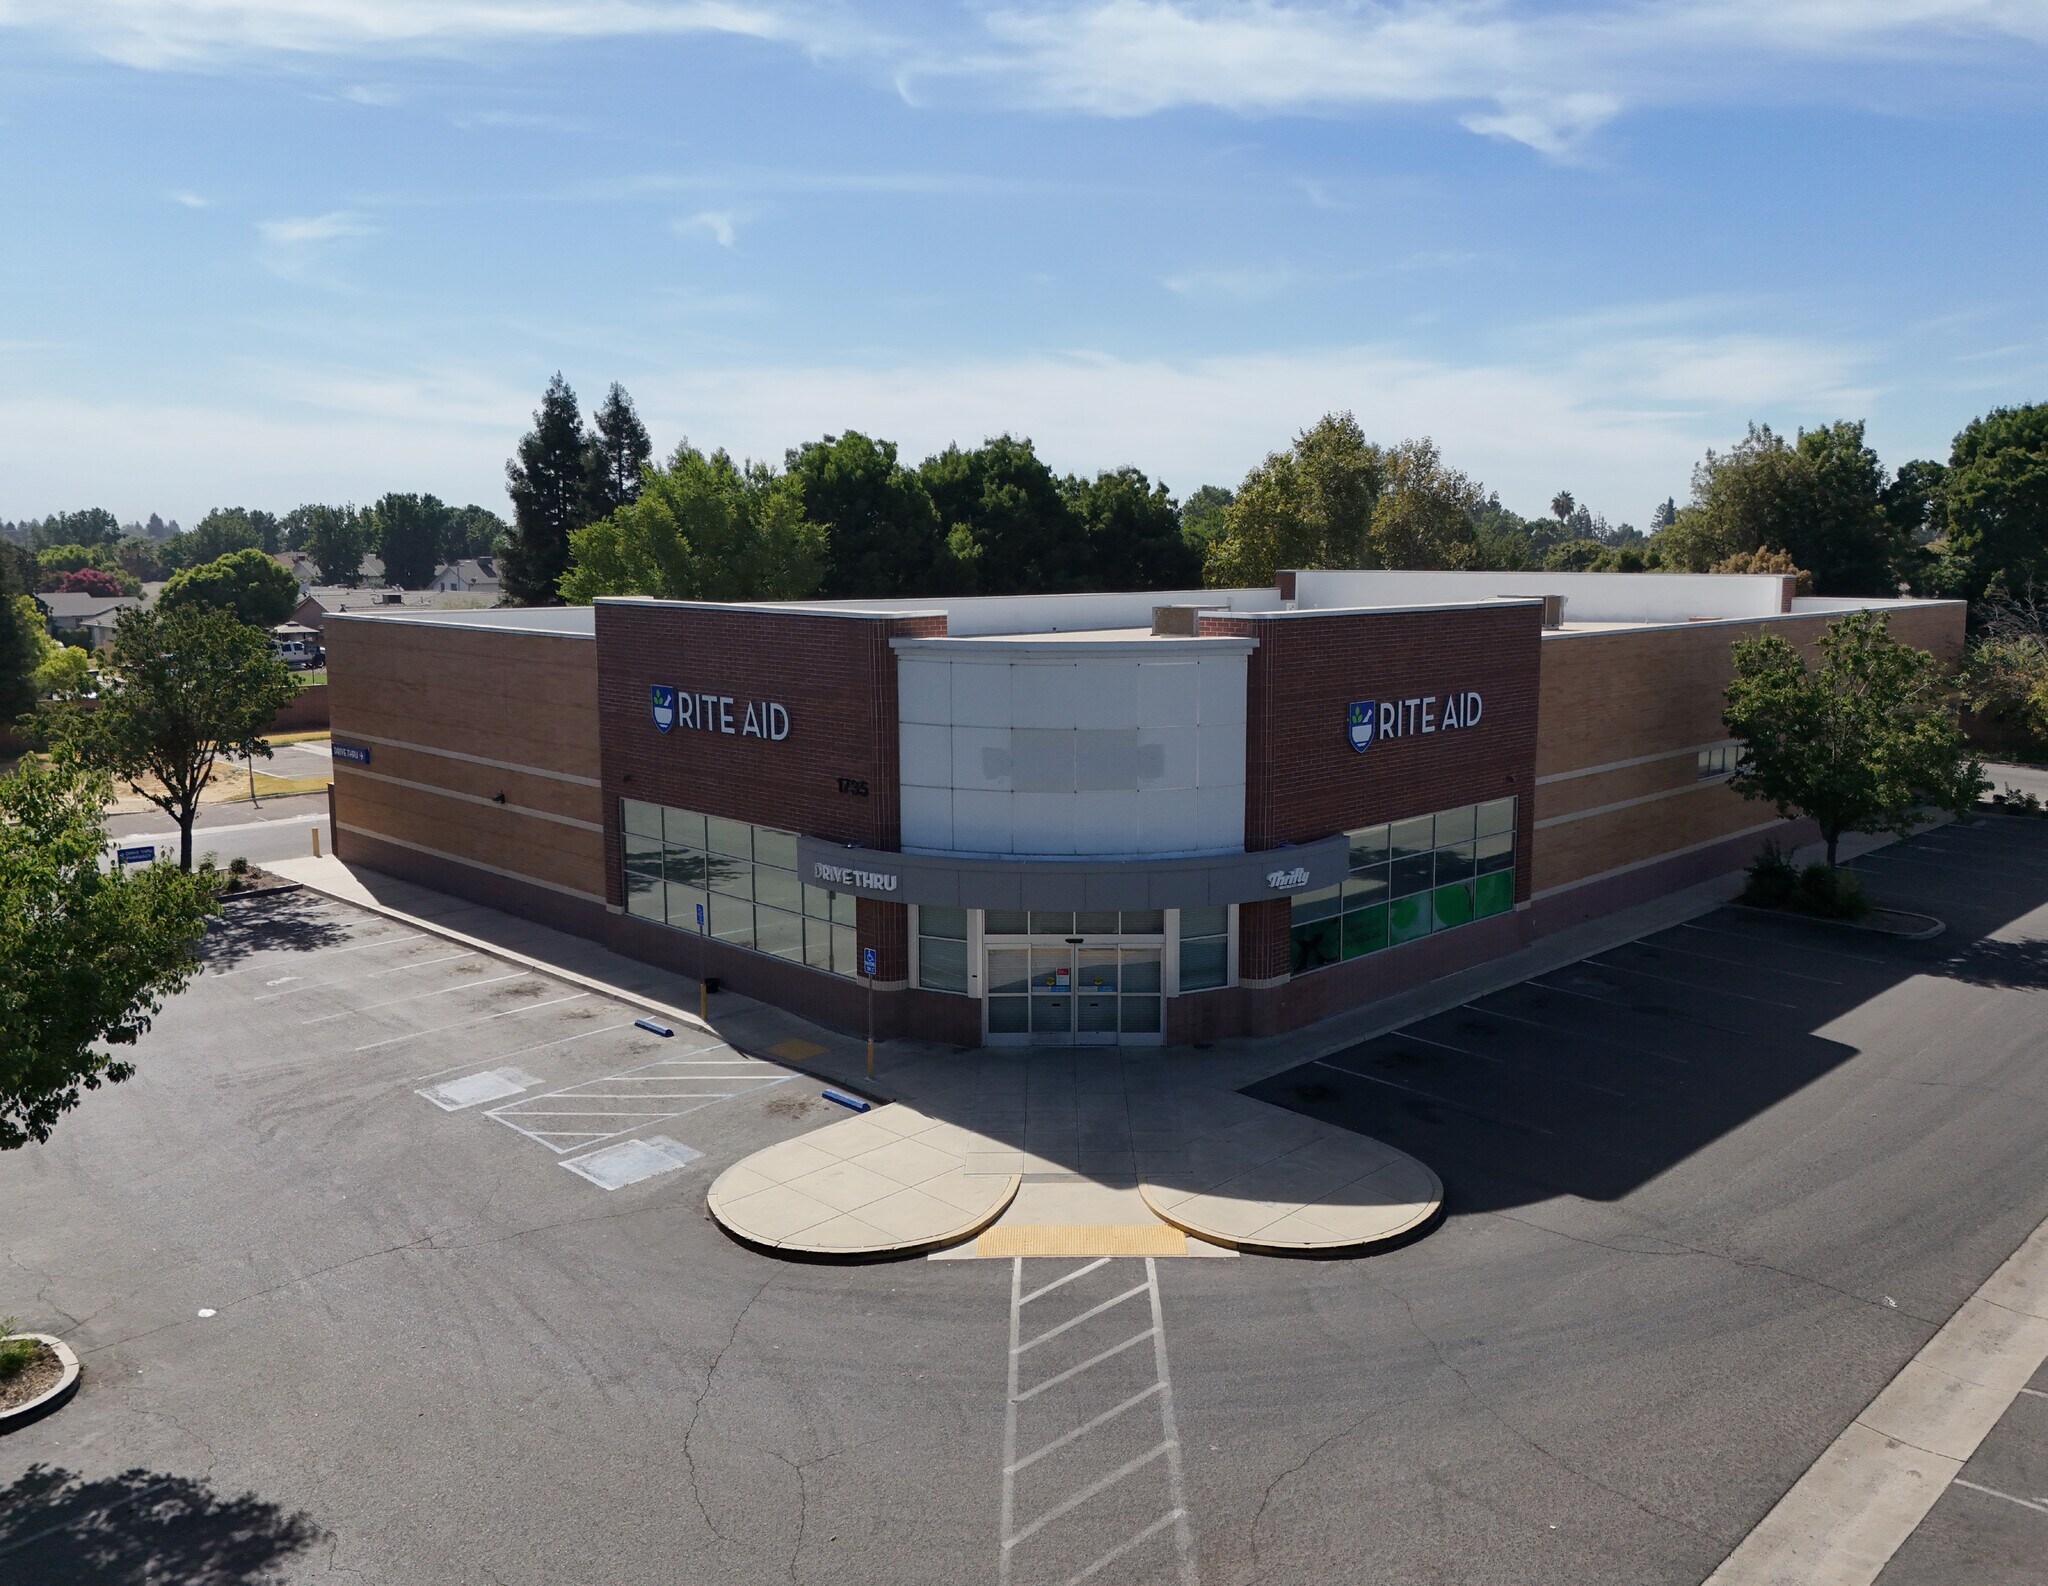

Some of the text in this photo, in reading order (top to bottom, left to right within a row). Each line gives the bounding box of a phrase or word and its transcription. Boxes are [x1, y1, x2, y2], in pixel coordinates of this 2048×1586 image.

[678, 691, 790, 741] RITE AID
[1379, 692, 1483, 740] RITE AID
[814, 862, 898, 892] DRIVE THRU
[1266, 867, 1310, 888] Thrifty
